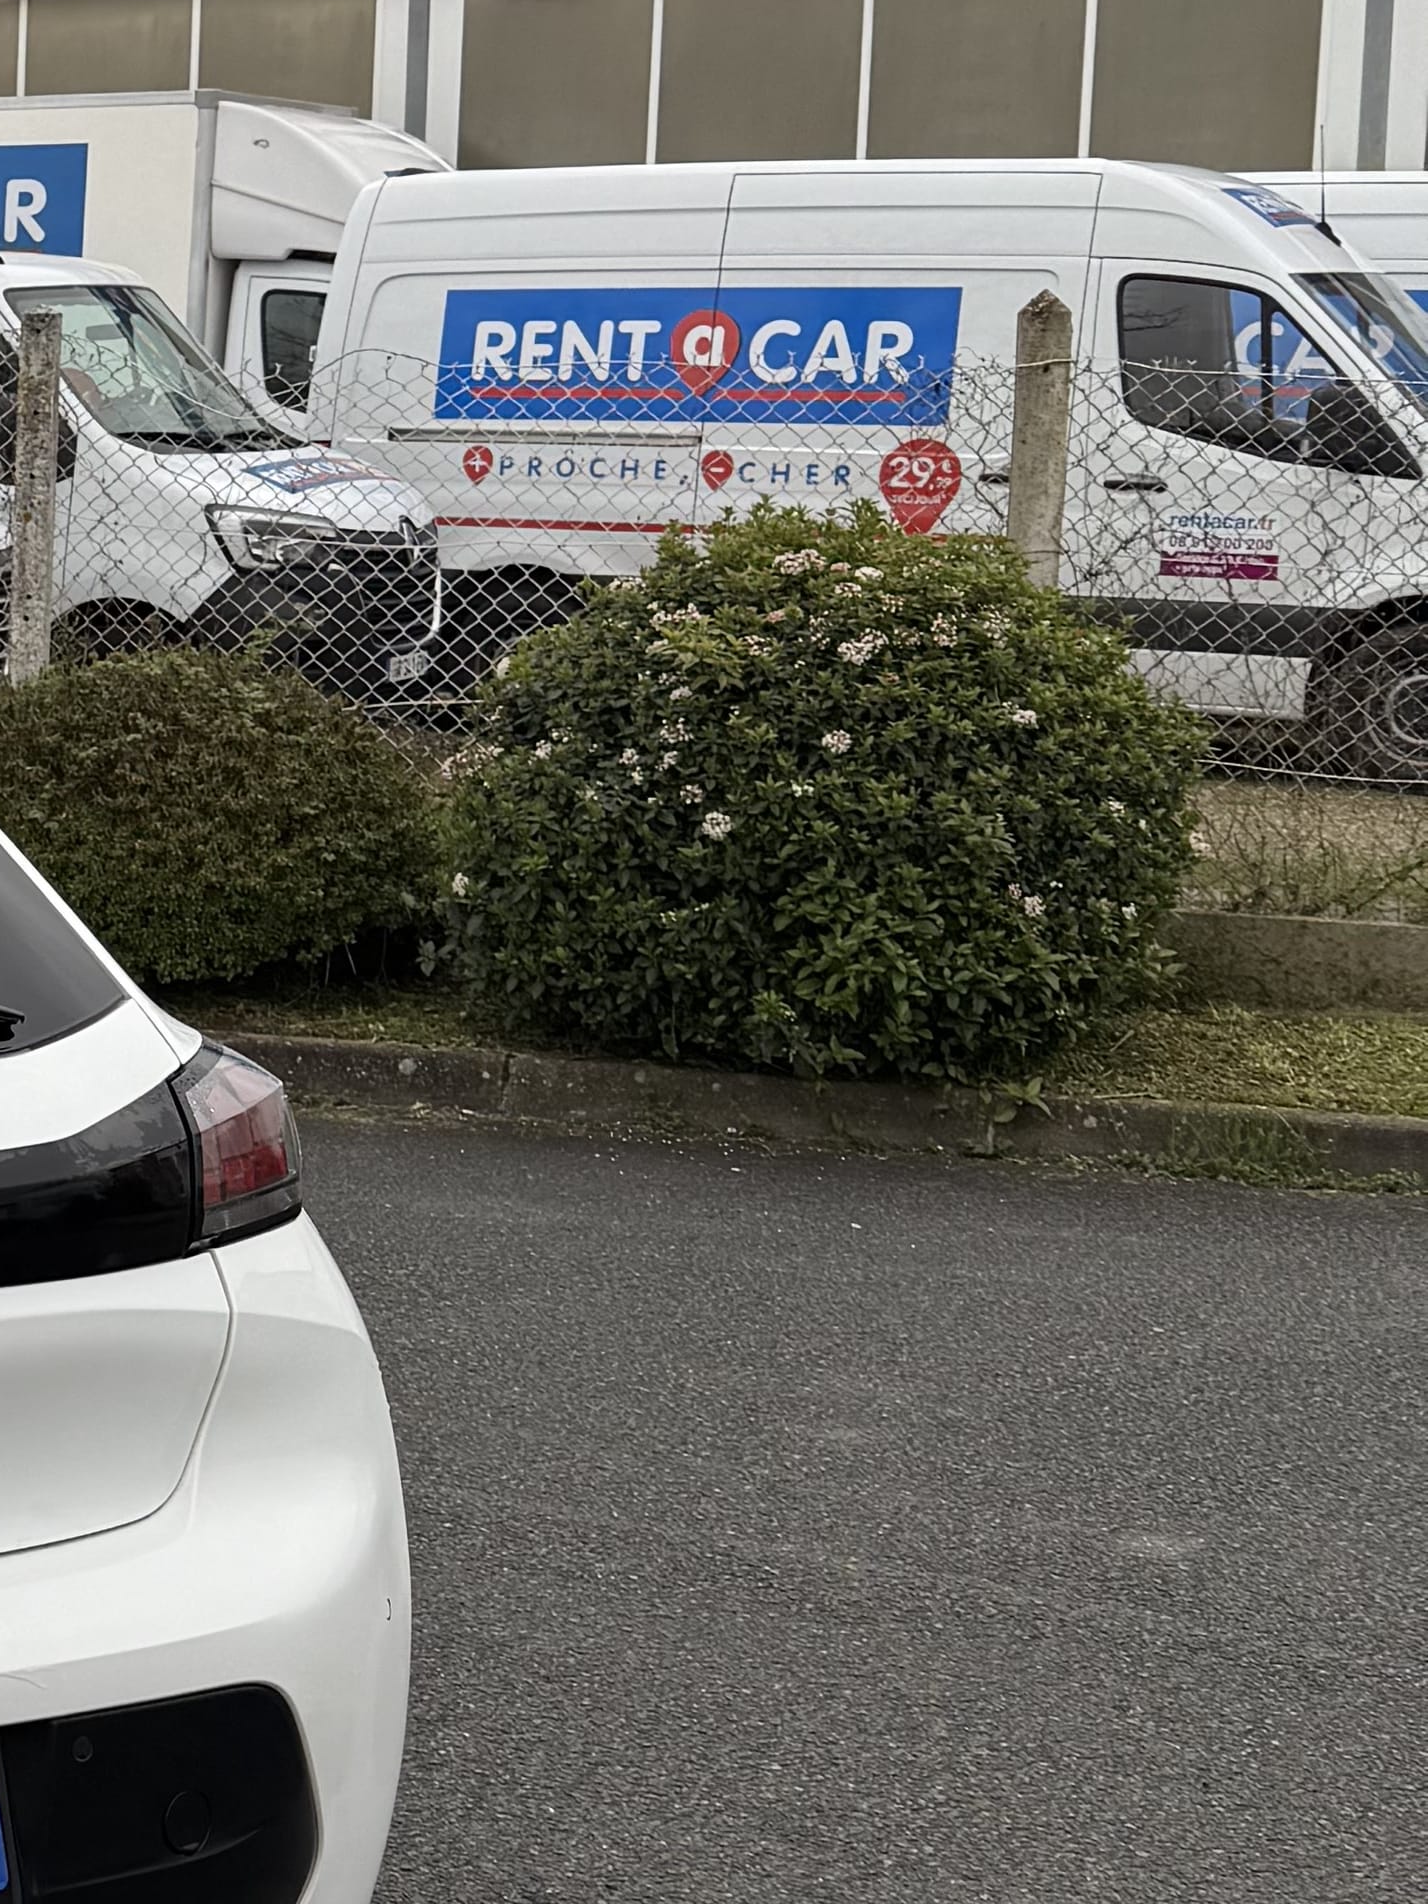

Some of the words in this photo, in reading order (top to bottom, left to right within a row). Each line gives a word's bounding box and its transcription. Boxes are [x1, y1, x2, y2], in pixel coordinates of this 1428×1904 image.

[470, 319, 661, 382] RENT
[683, 324, 725, 367] a
[748, 319, 915, 384] CAR
[738, 461, 852, 487] CHER
